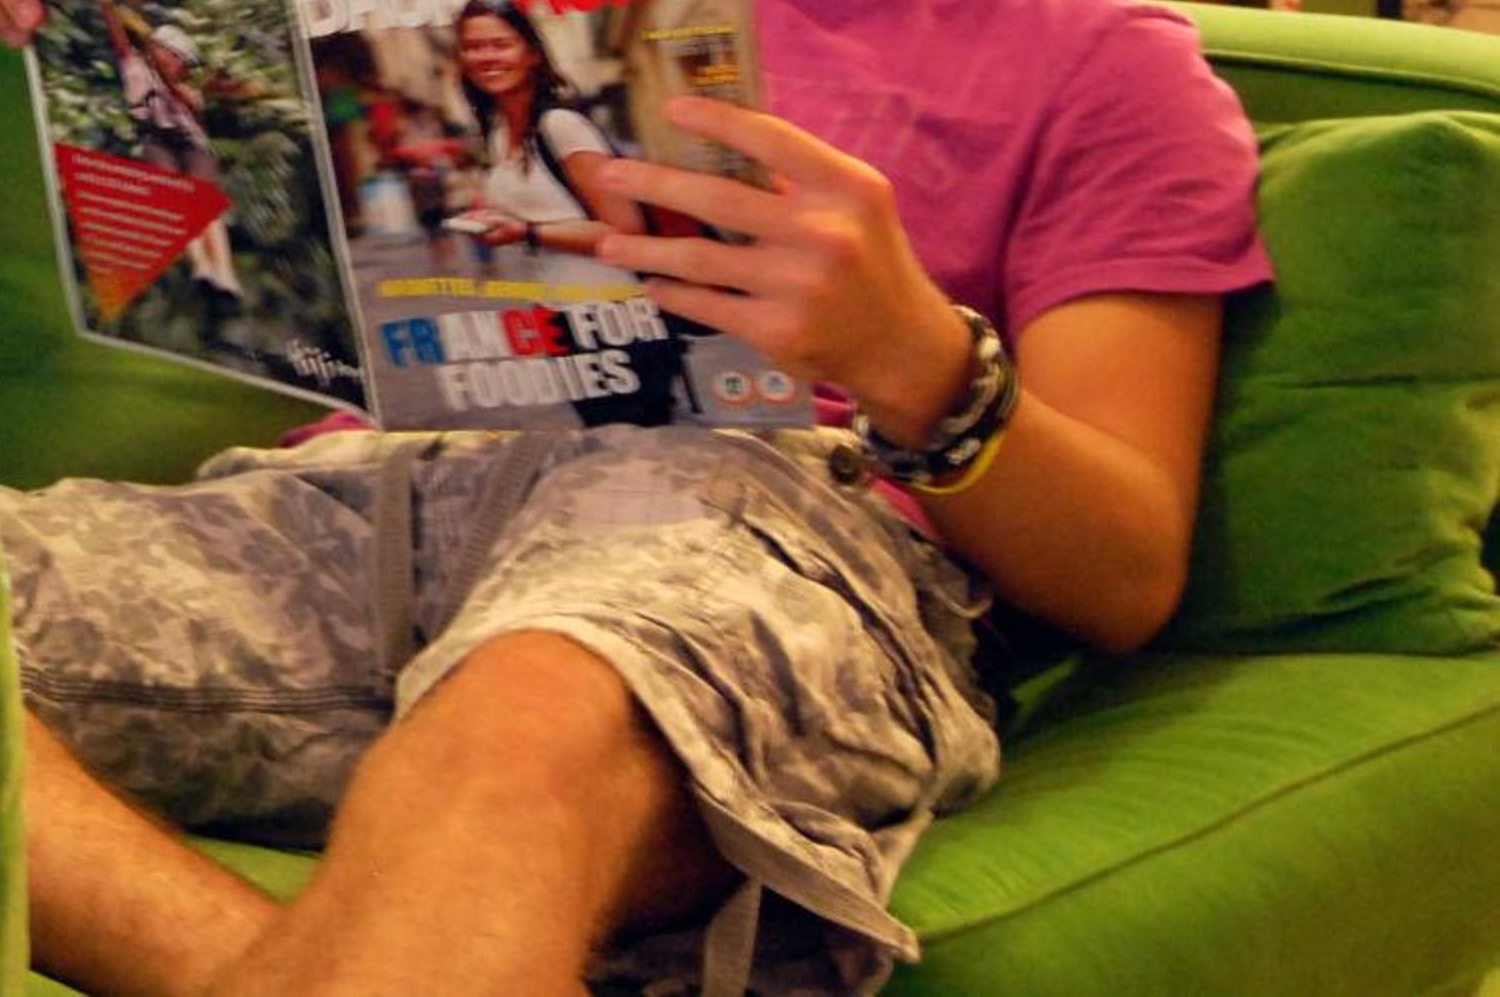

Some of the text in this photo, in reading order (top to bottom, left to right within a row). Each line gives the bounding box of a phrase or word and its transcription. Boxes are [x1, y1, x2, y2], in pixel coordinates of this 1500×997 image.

[379, 309, 573, 369] FRANCE
[565, 298, 670, 350] FOR
[438, 349, 641, 411] FOODIES
